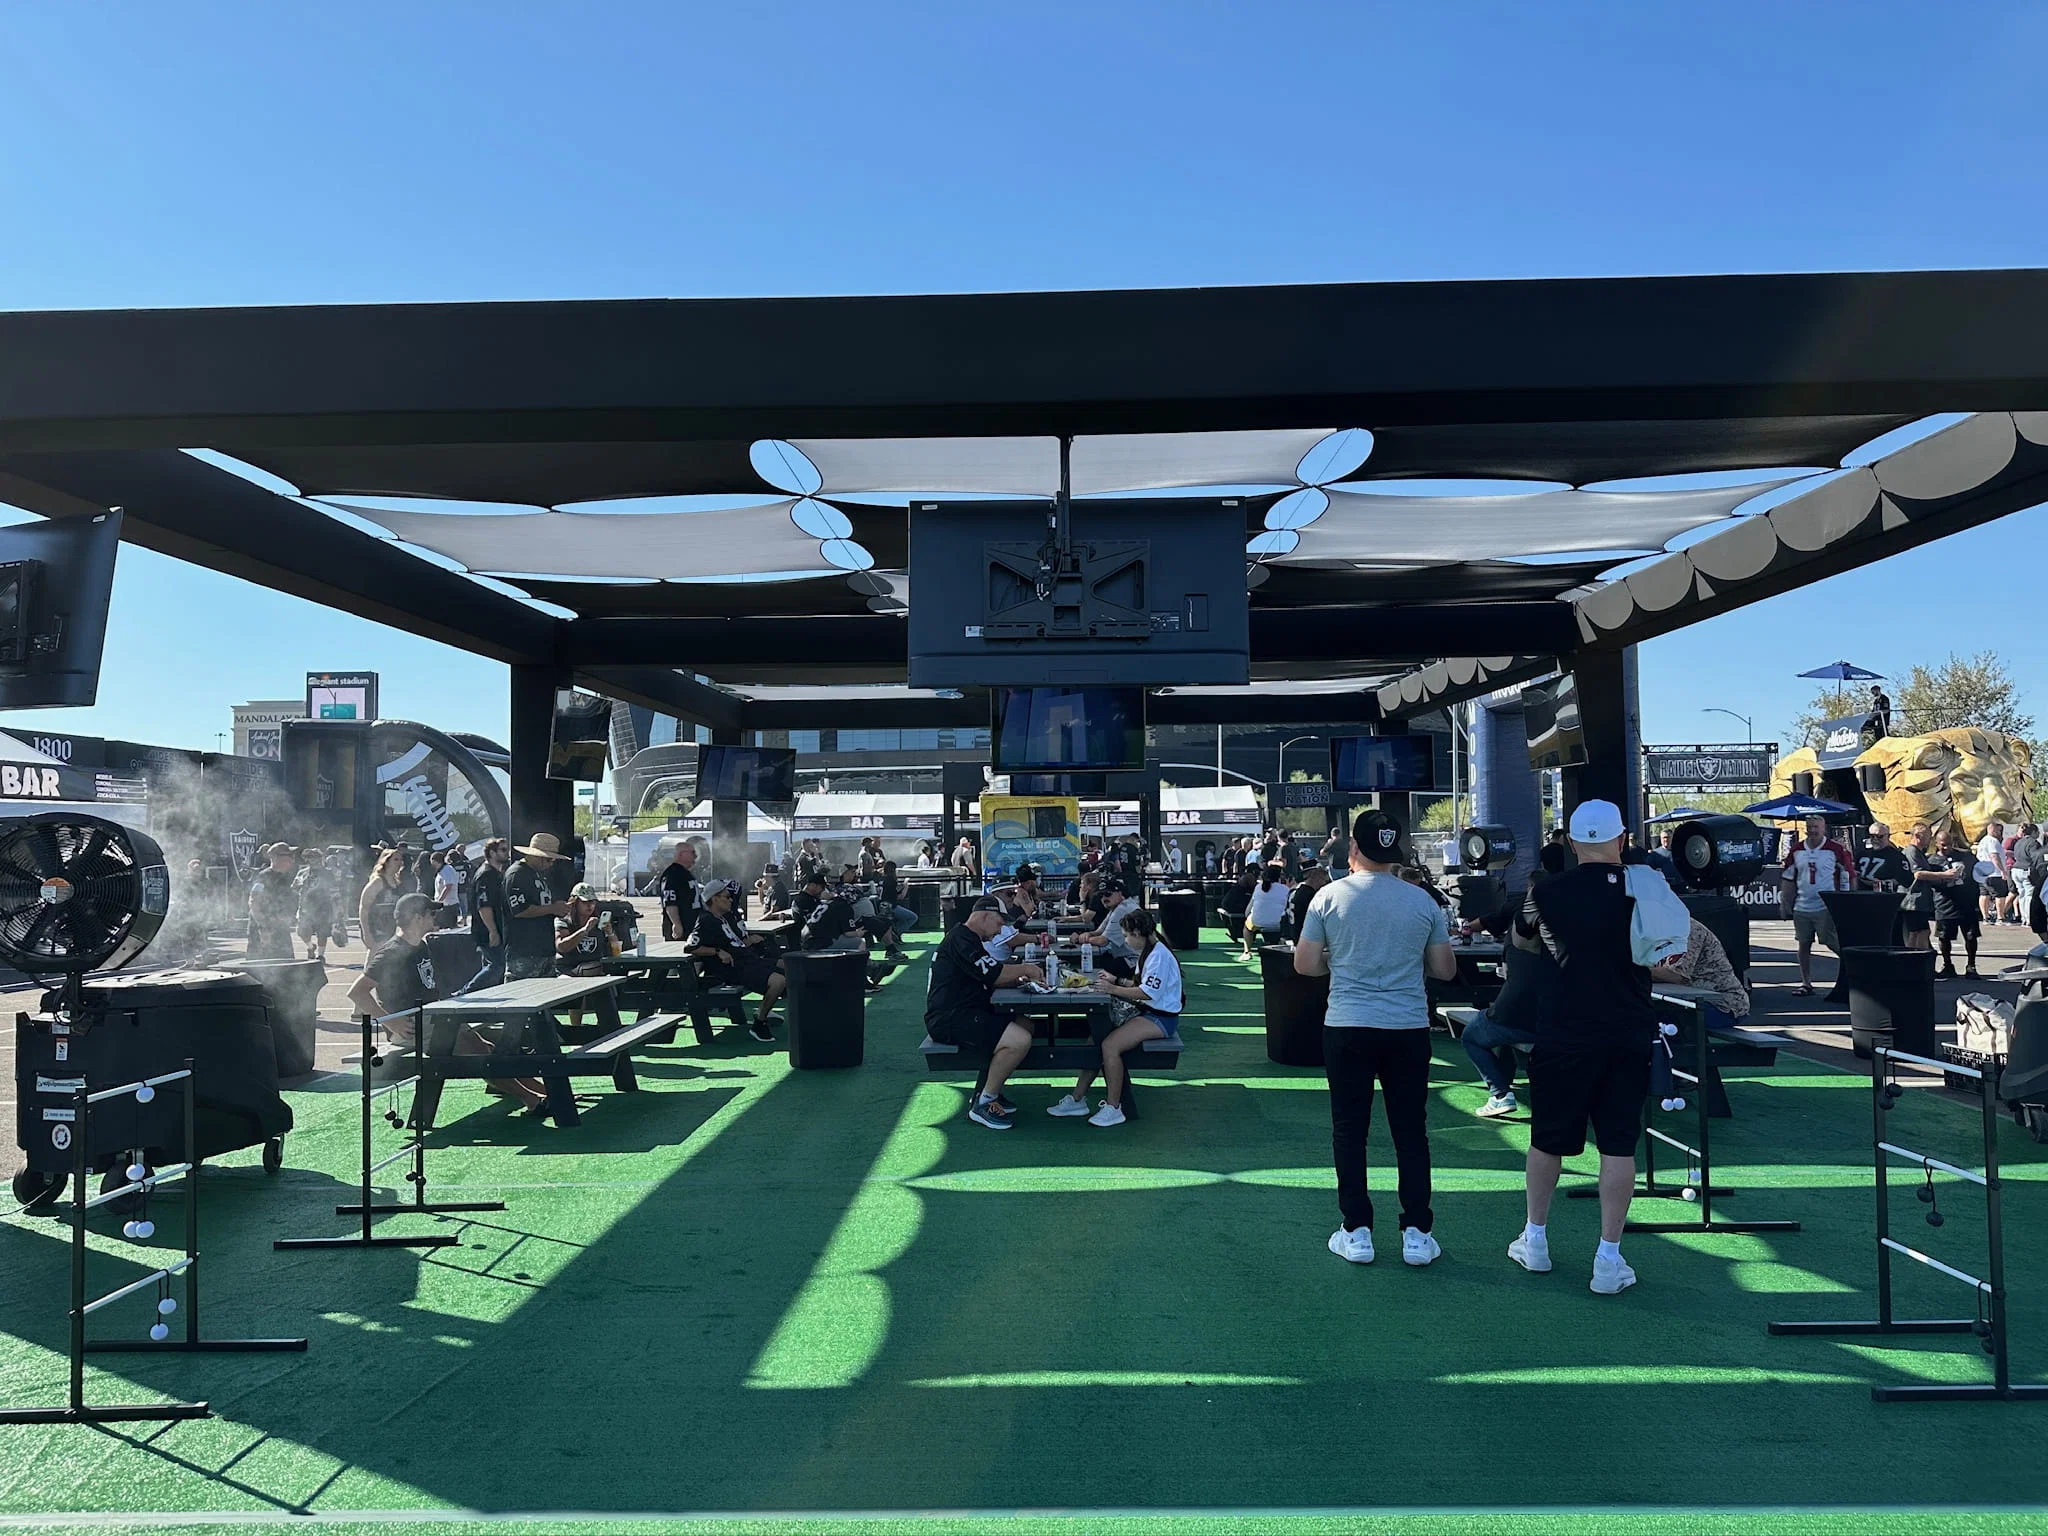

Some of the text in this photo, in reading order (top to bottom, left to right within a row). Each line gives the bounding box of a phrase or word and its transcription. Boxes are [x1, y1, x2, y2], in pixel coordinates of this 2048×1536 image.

[340, 676, 369, 685] stadium
[235, 714, 293, 722] MANDALAY
[33, 736, 72, 760] 1800
[252, 743, 279, 757] ON
[1660, 759, 1759, 779] RAIDER NATION
[1, 765, 60, 797] BAR
[677, 819, 709, 829] FIRST
[851, 816, 884, 829] BAR
[1166, 811, 1201, 825] BAR
[1859, 856, 1885, 880] 37
[509, 894, 526, 908] 24
[974, 956, 997, 976] 75
[1146, 975, 1162, 990] 83
